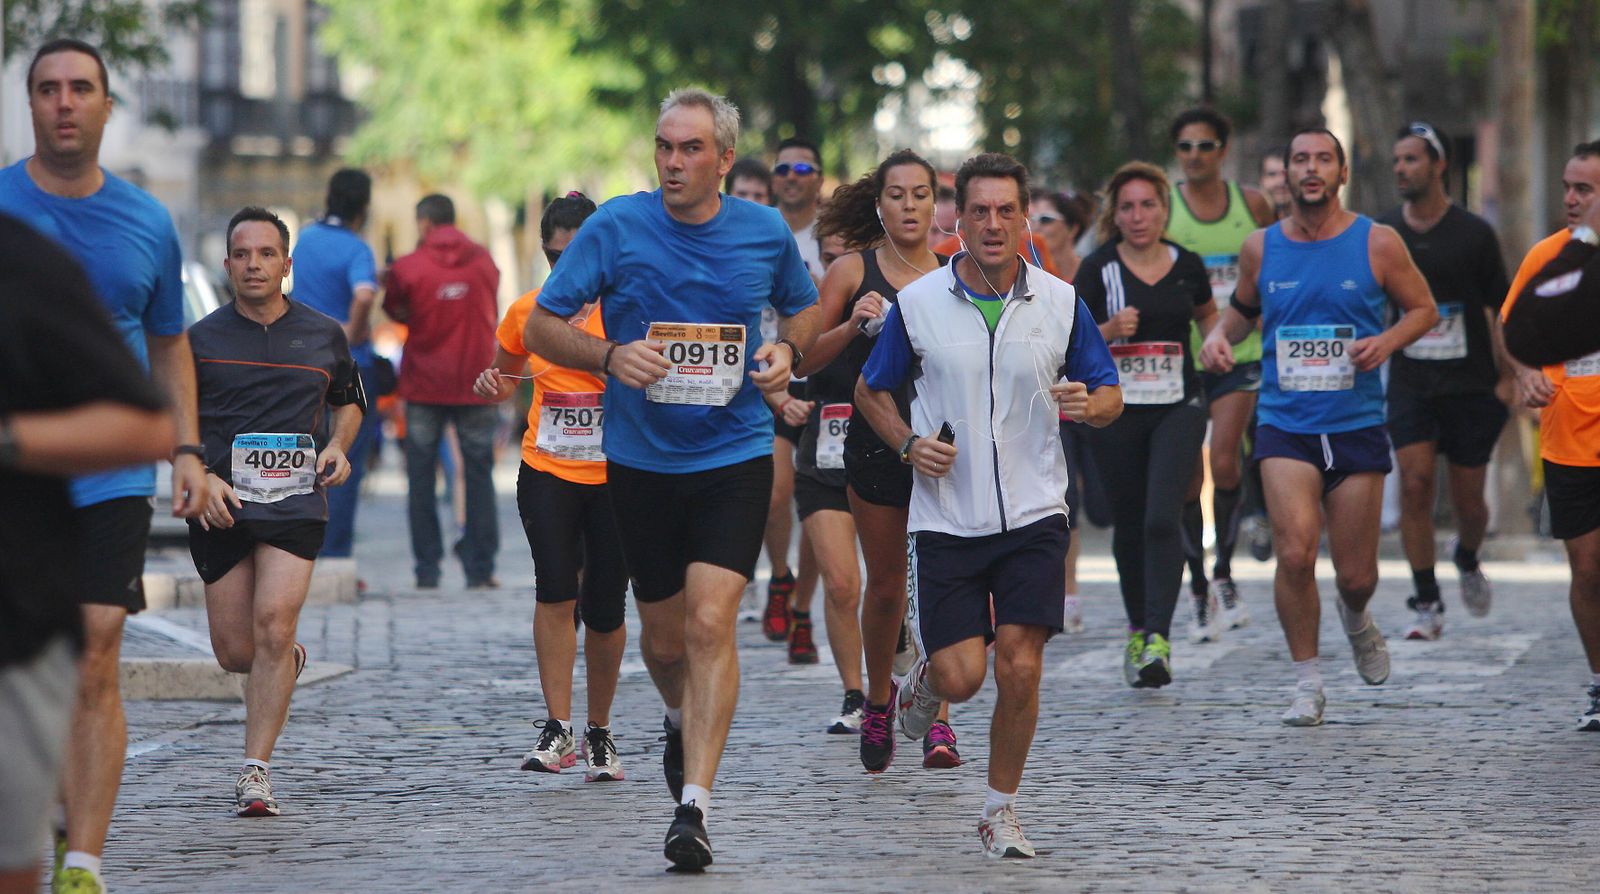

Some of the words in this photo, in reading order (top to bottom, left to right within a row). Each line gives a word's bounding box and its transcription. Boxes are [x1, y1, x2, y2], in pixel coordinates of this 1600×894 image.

[658, 342, 739, 366] 0918
[1288, 340, 1344, 358] 2930
[1120, 357, 1172, 373] 6314
[549, 407, 604, 427] 7507
[244, 449, 306, 469] 4020
